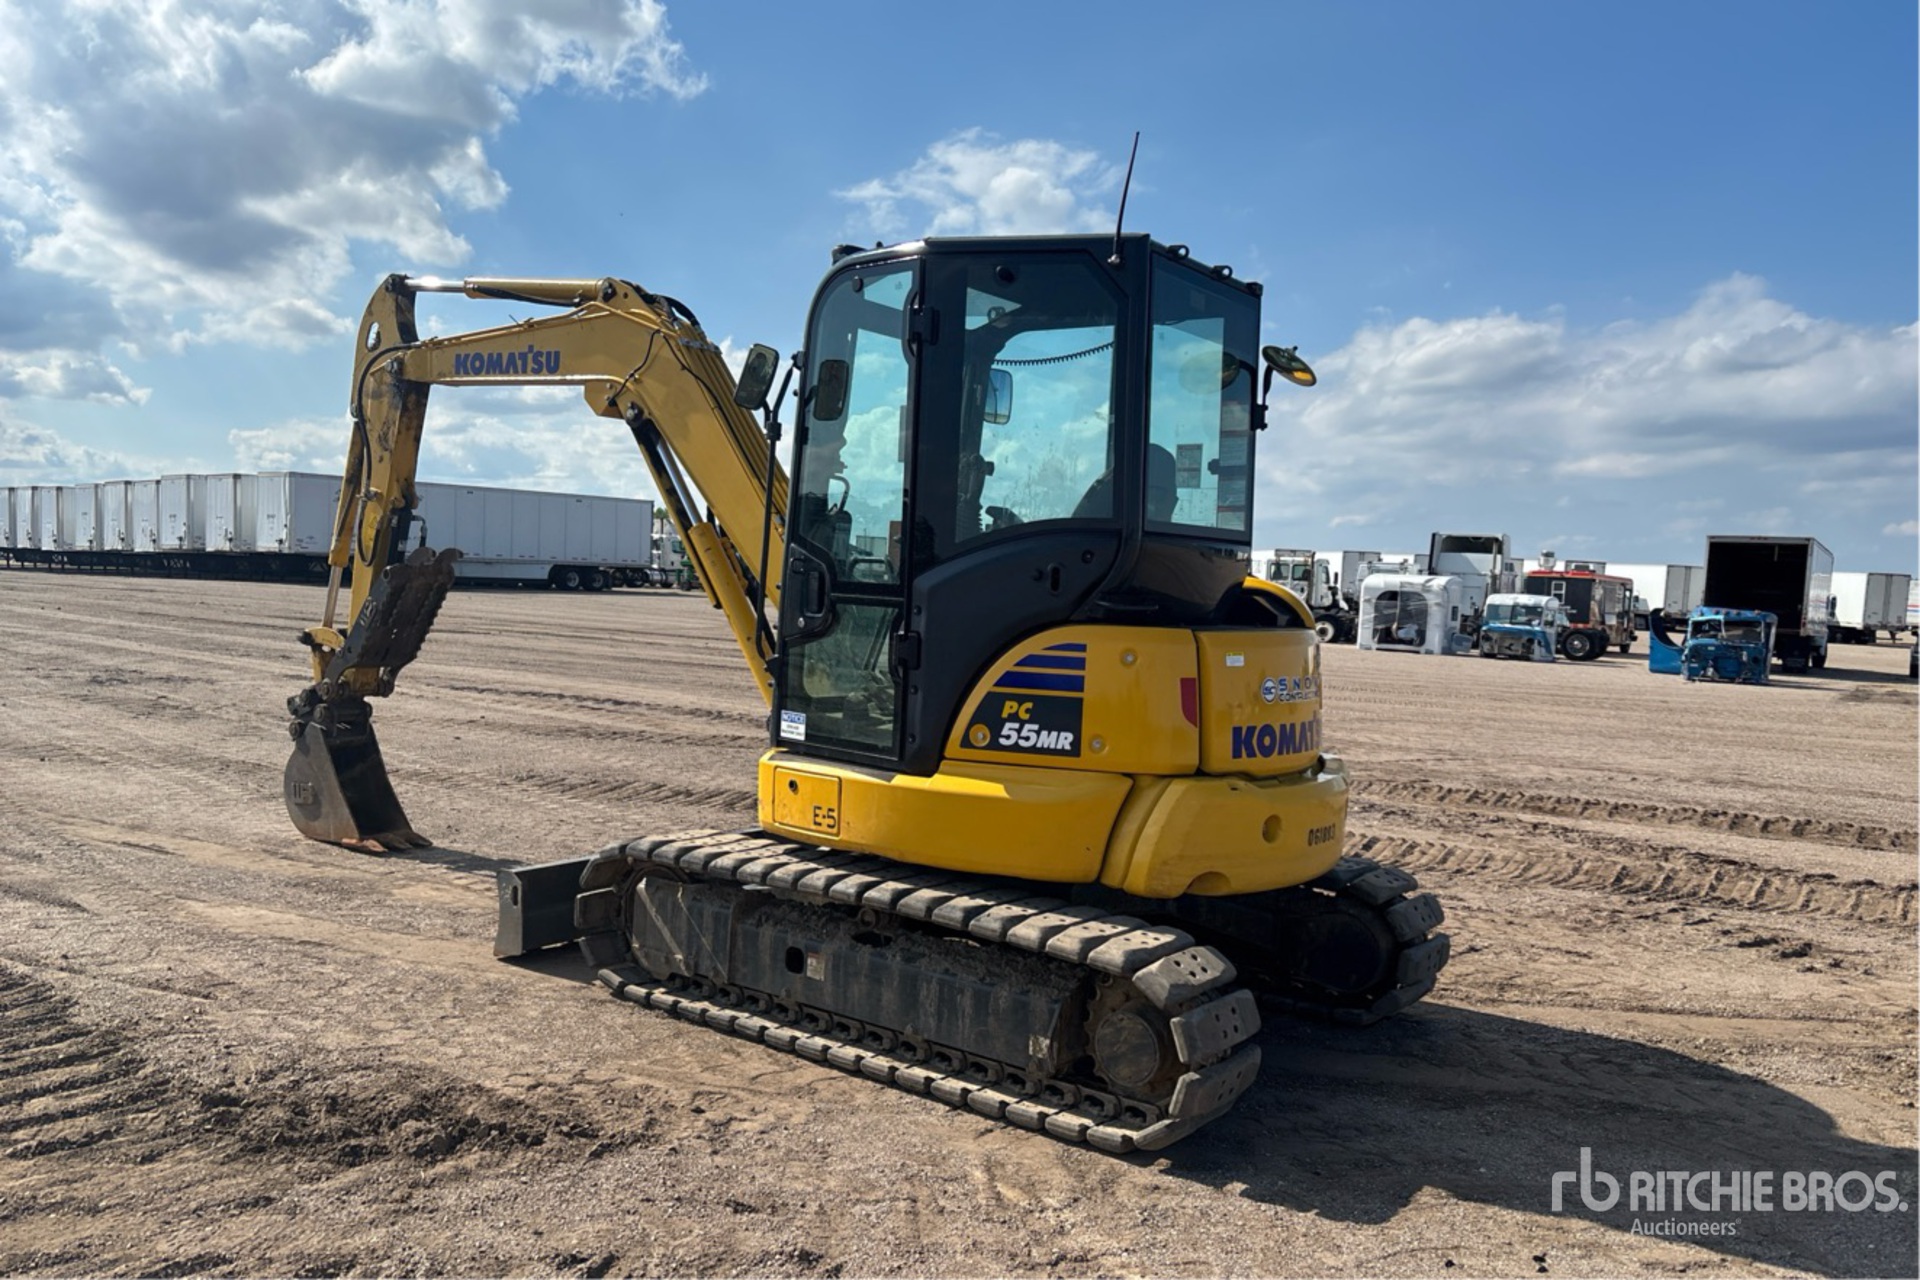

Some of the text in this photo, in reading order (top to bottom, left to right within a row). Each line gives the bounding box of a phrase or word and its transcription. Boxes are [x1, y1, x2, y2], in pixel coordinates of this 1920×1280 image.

[454, 345, 560, 375] KOMATSU
[1001, 701, 1033, 720] PC
[998, 722, 1074, 750] 55MR
[813, 805, 837, 829] E-5
